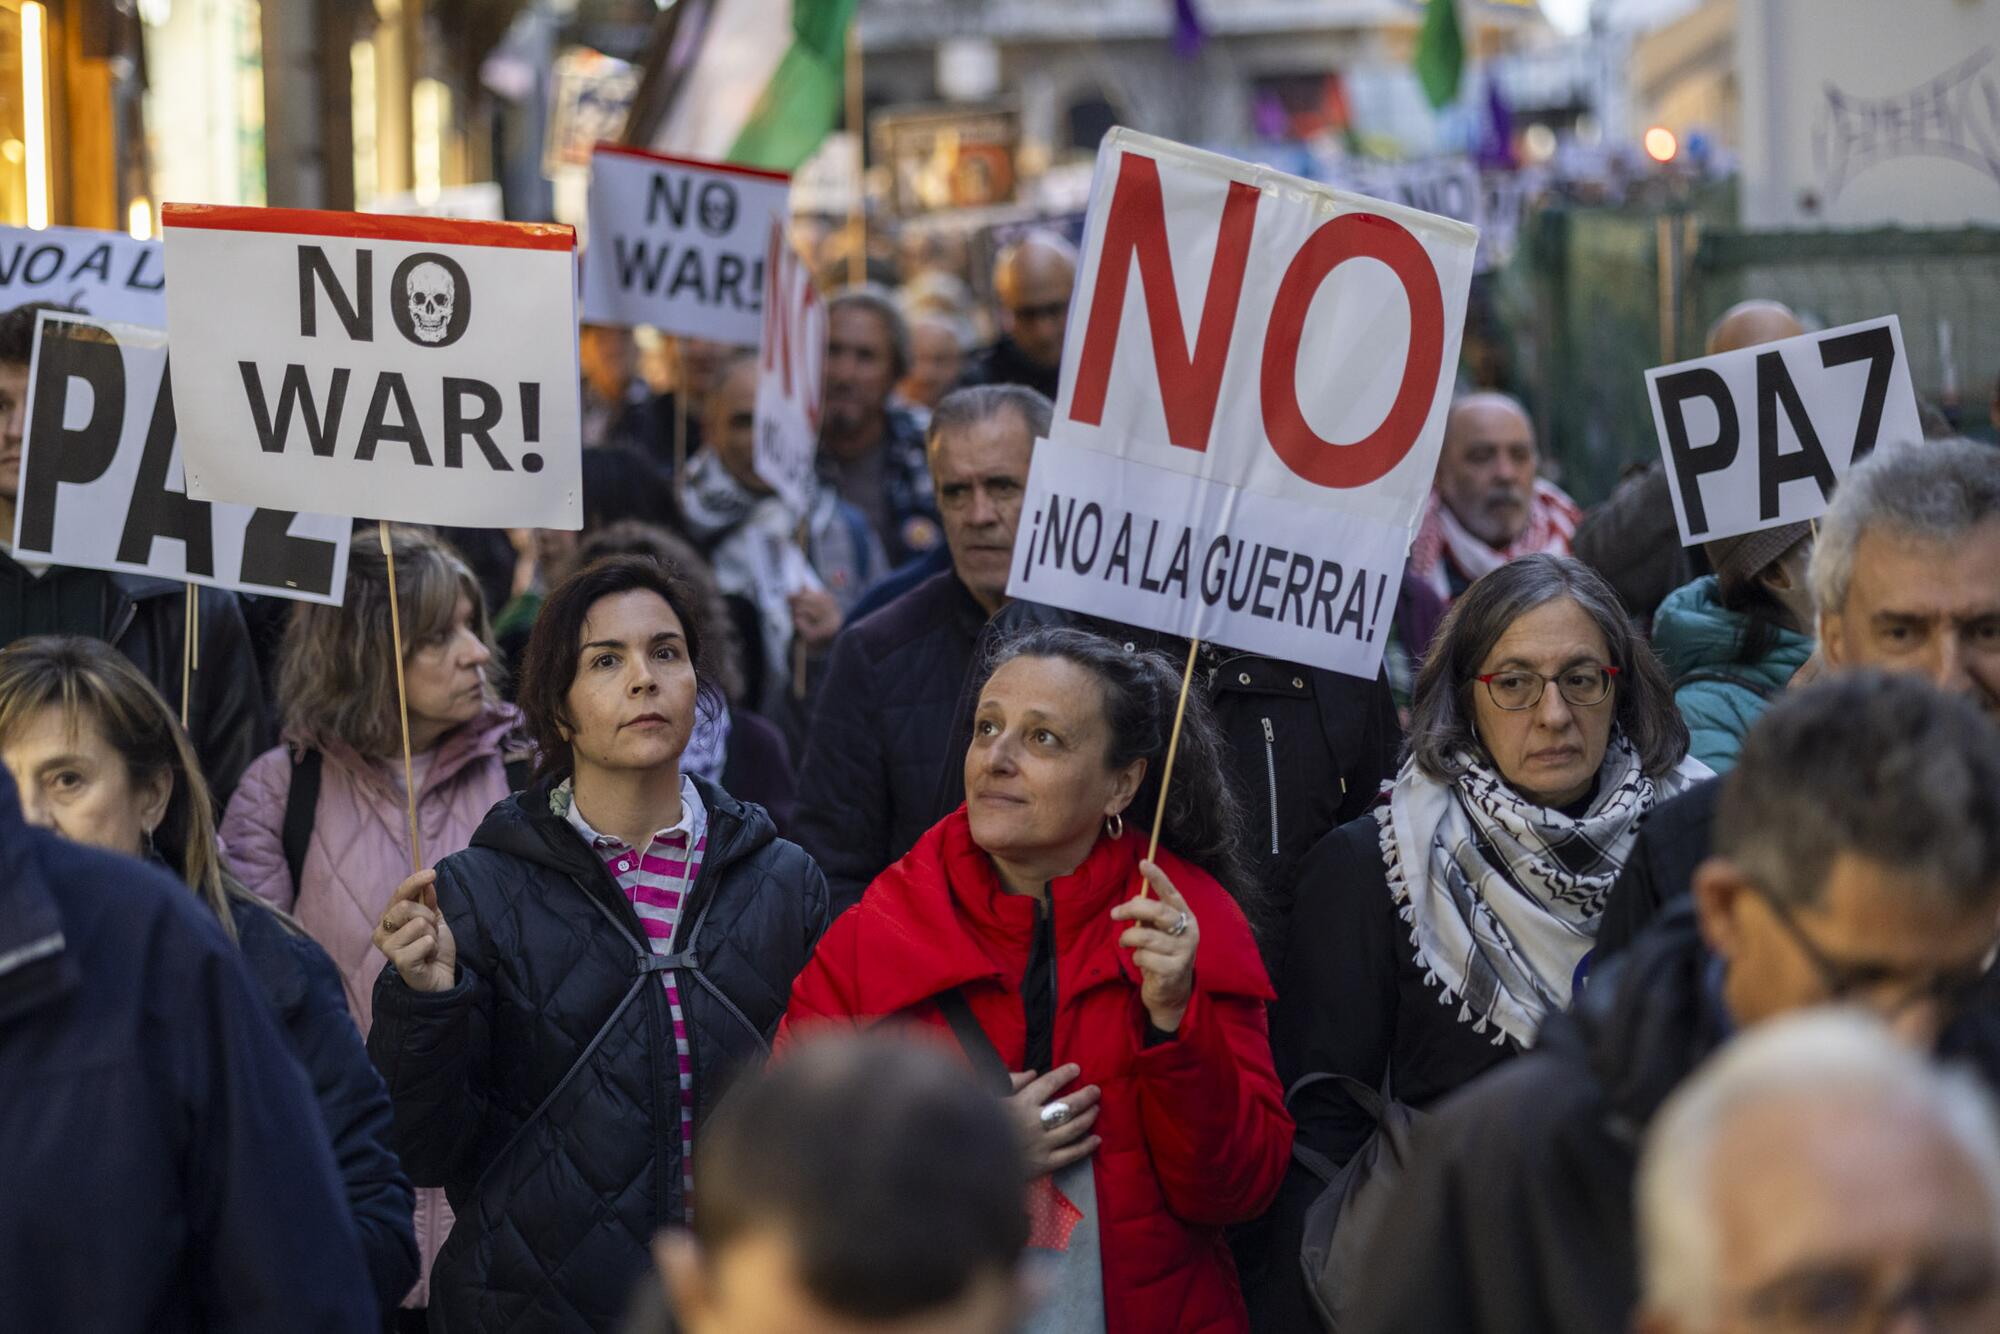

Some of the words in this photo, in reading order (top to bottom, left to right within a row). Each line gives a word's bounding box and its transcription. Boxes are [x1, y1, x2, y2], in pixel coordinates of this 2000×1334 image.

[645, 172, 739, 238] NO
[68, 240, 112, 282] A
[125, 246, 165, 291] L
[297, 244, 472, 348] NO
[1069, 151, 1445, 489] NO
[238, 360, 544, 473] WAR!
[1023, 494, 1104, 583] ¡NO
[1104, 511, 1133, 586] A
[1139, 519, 1193, 600] LA
[1200, 534, 1388, 643] GUERRA!
